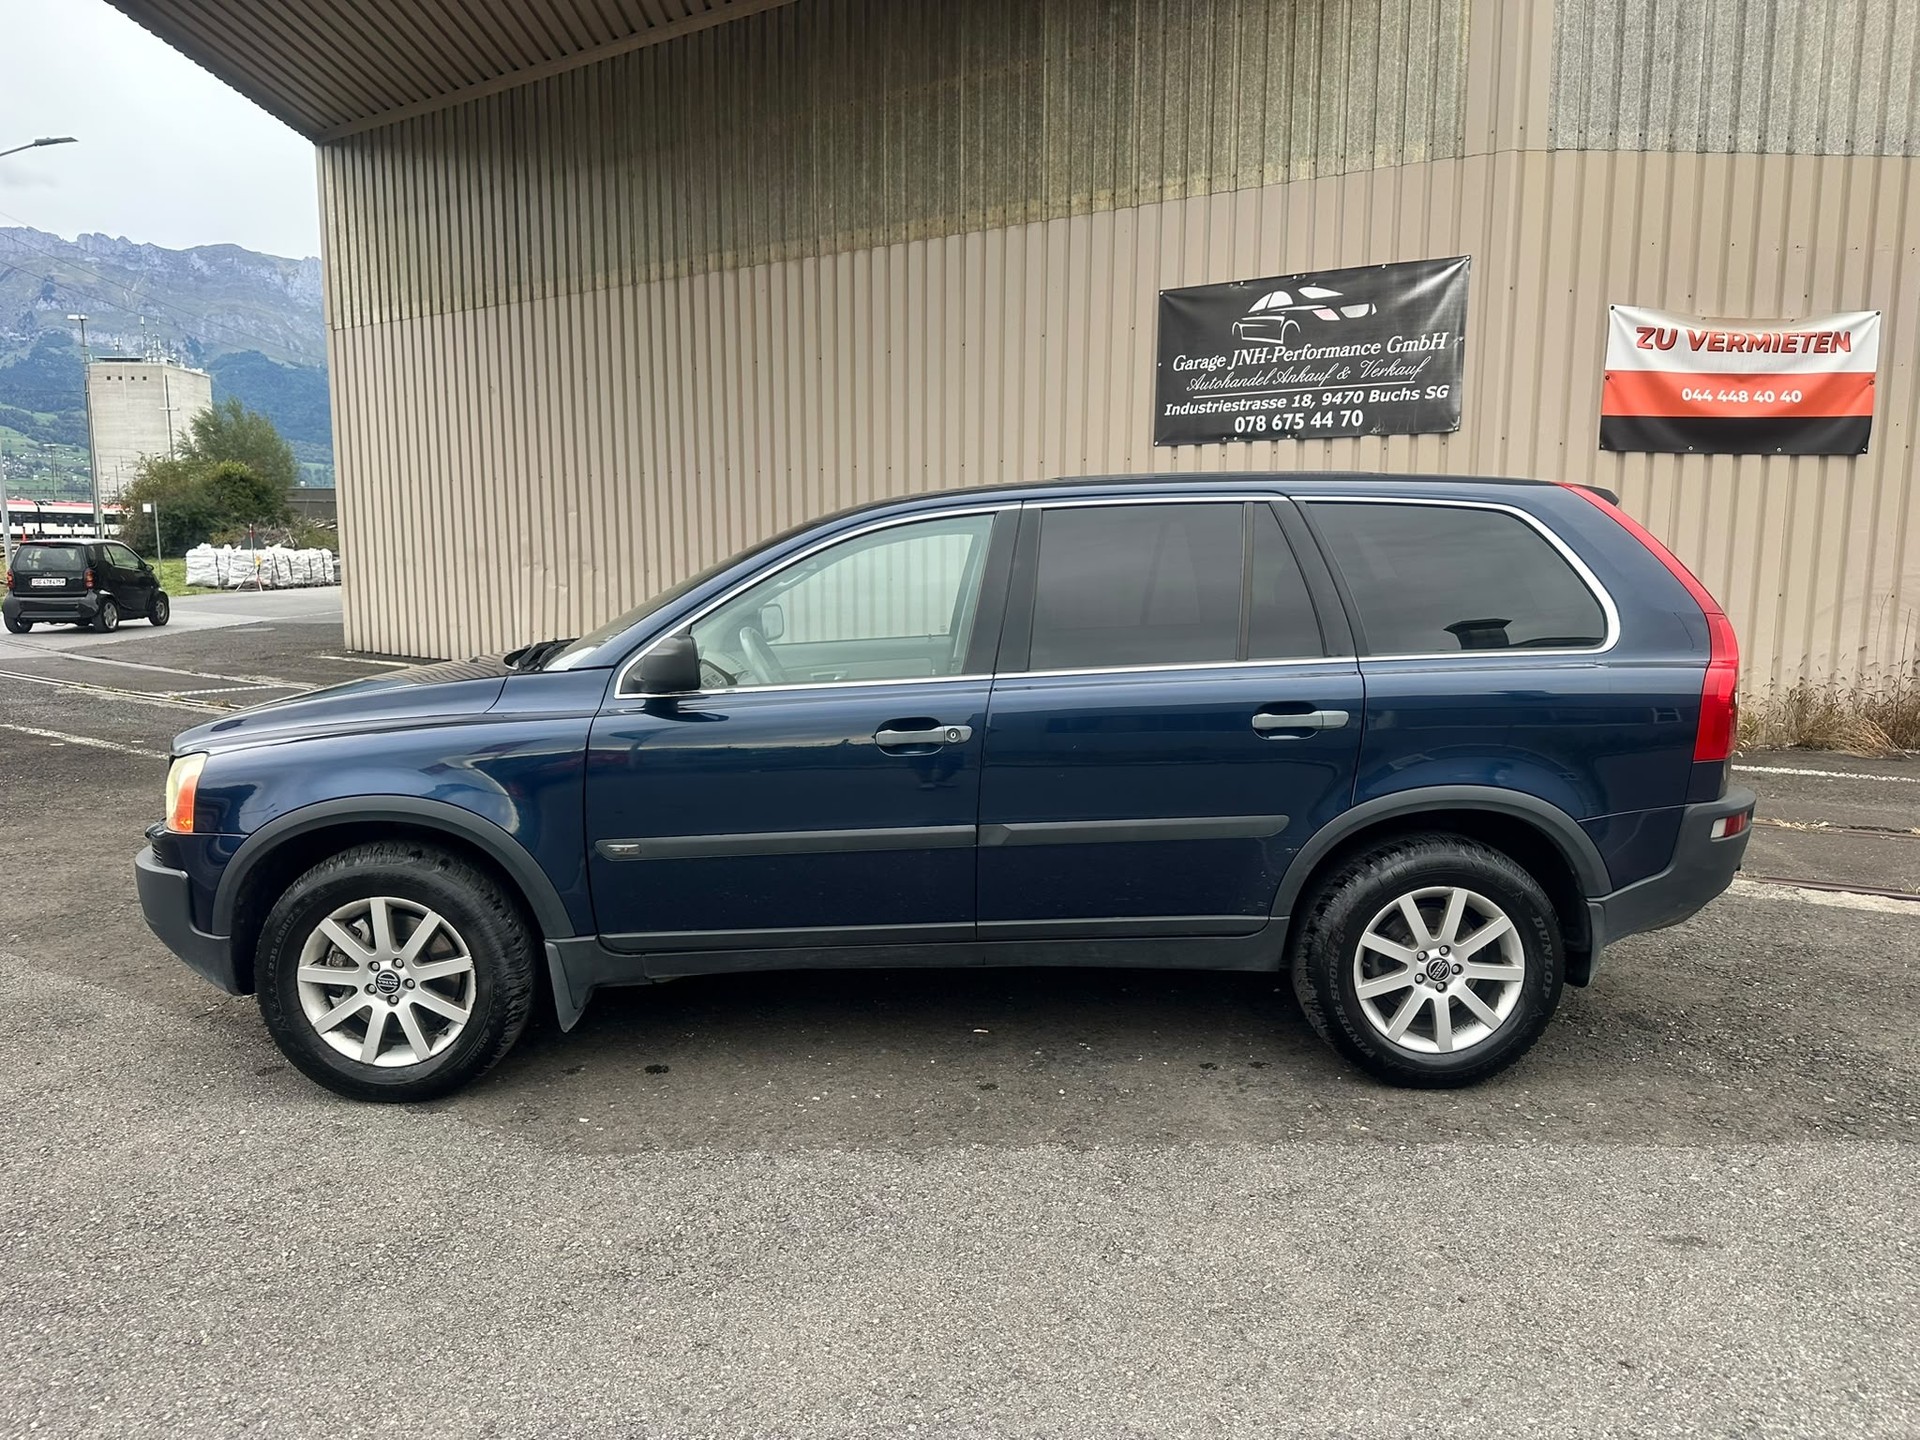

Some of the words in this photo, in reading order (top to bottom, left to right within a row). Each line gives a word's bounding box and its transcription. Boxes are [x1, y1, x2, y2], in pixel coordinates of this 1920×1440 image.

[1172, 354, 1227, 372] Garage
[1227, 341, 1382, 371] JNH-Performance
[1386, 332, 1450, 353] GmbH
[1635, 326, 1679, 351] ZU
[1686, 328, 1852, 354] VERMIETEN
[1186, 368, 1274, 392] Autohandel
[1272, 364, 1336, 388] Ankauf
[1336, 366, 1351, 380] &
[1360, 356, 1431, 385] Verkauf
[1164, 395, 1287, 417] Industriestrasse
[1291, 395, 1316, 410] 18,
[1322, 390, 1364, 406] 9470
[1368, 388, 1419, 403] Buchs
[1425, 385, 1450, 399] SG
[1681, 388, 1713, 402] 044
[1716, 389, 1749, 404] 448
[1753, 390, 1776, 404] 40
[1779, 390, 1803, 404] 40
[1234, 415, 1267, 433] 078
[1271, 413, 1304, 431] 675
[1310, 412, 1334, 429] 44
[1340, 409, 1364, 428] 70
[1530, 915, 1554, 1000] DUNLOP
[1335, 1004, 1377, 1058] WINTER
